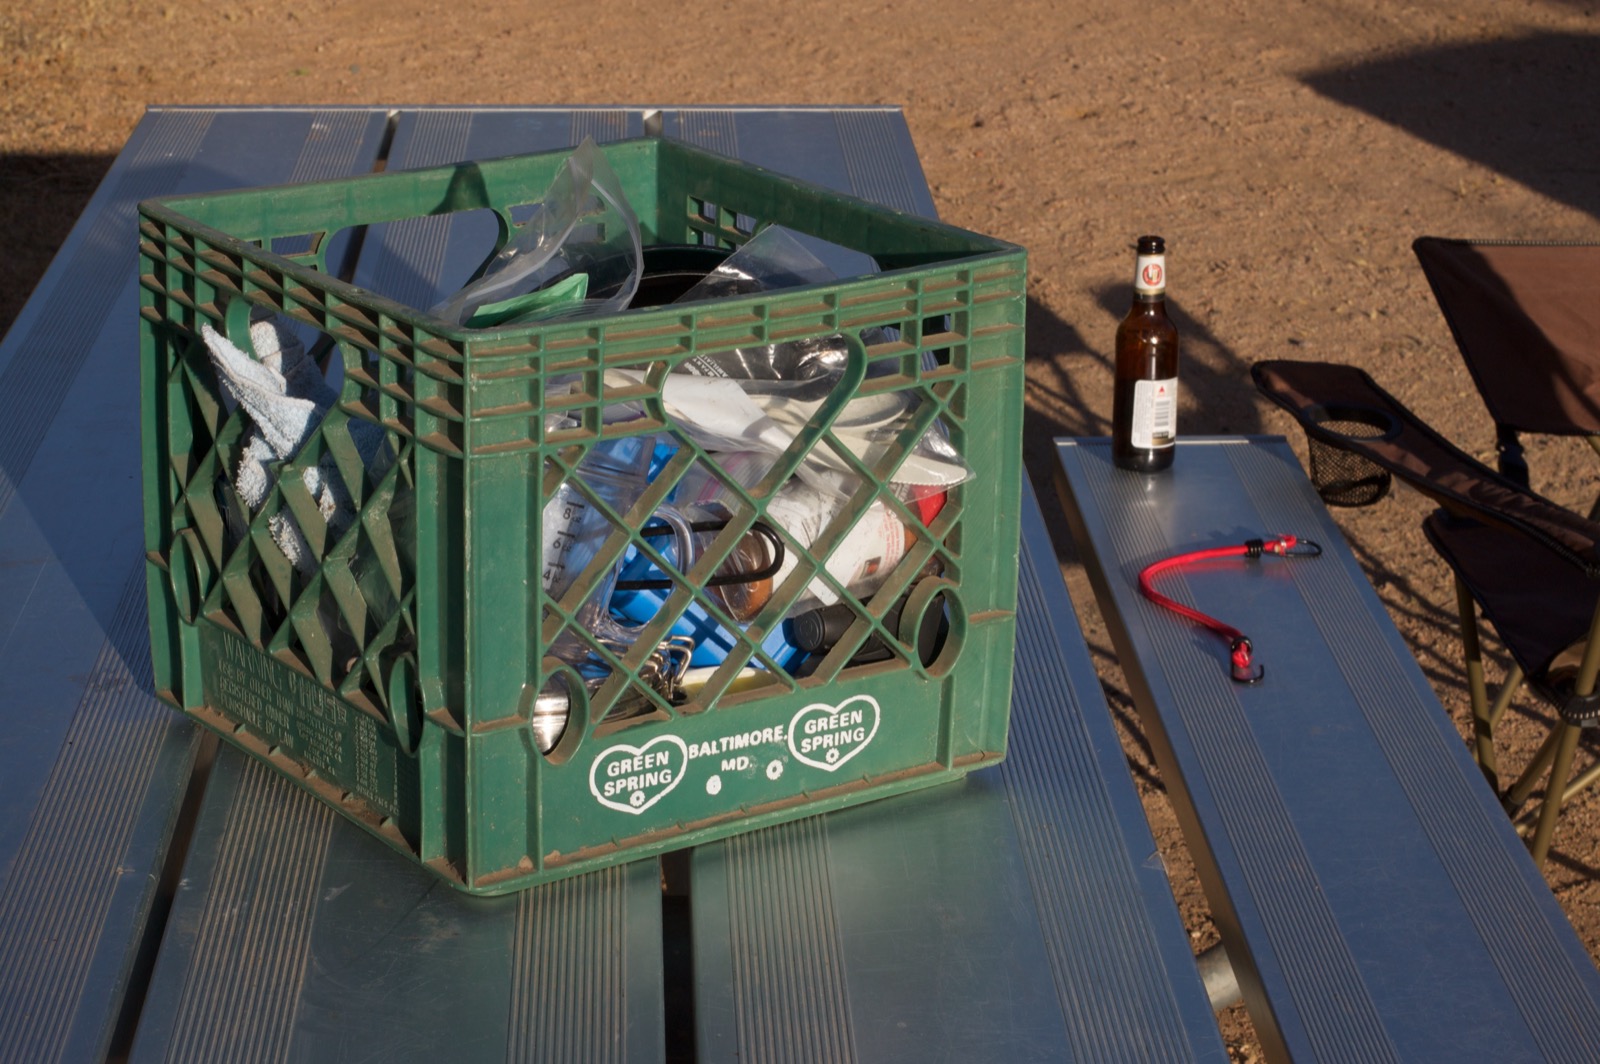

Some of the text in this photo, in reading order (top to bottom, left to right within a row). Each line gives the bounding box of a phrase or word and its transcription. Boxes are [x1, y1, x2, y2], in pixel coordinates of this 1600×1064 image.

[563, 507, 572, 520] 8
[553, 537, 561, 549] 6
[543, 569, 551, 581] 4
[223, 631, 282, 691] WARNING
[220, 675, 289, 730] REGISTERED OWNER
[237, 669, 246, 685] BY
[249, 678, 272, 702] OTHER
[276, 693, 294, 716] THAN
[265, 719, 275, 735] BY
[279, 727, 294, 749] LAW
[804, 710, 863, 734] GREEN
[801, 727, 865, 753] SPRING
[607, 751, 669, 777] GREEN
[721, 757, 753, 772] MD.
[604, 769, 672, 797] SPRING
